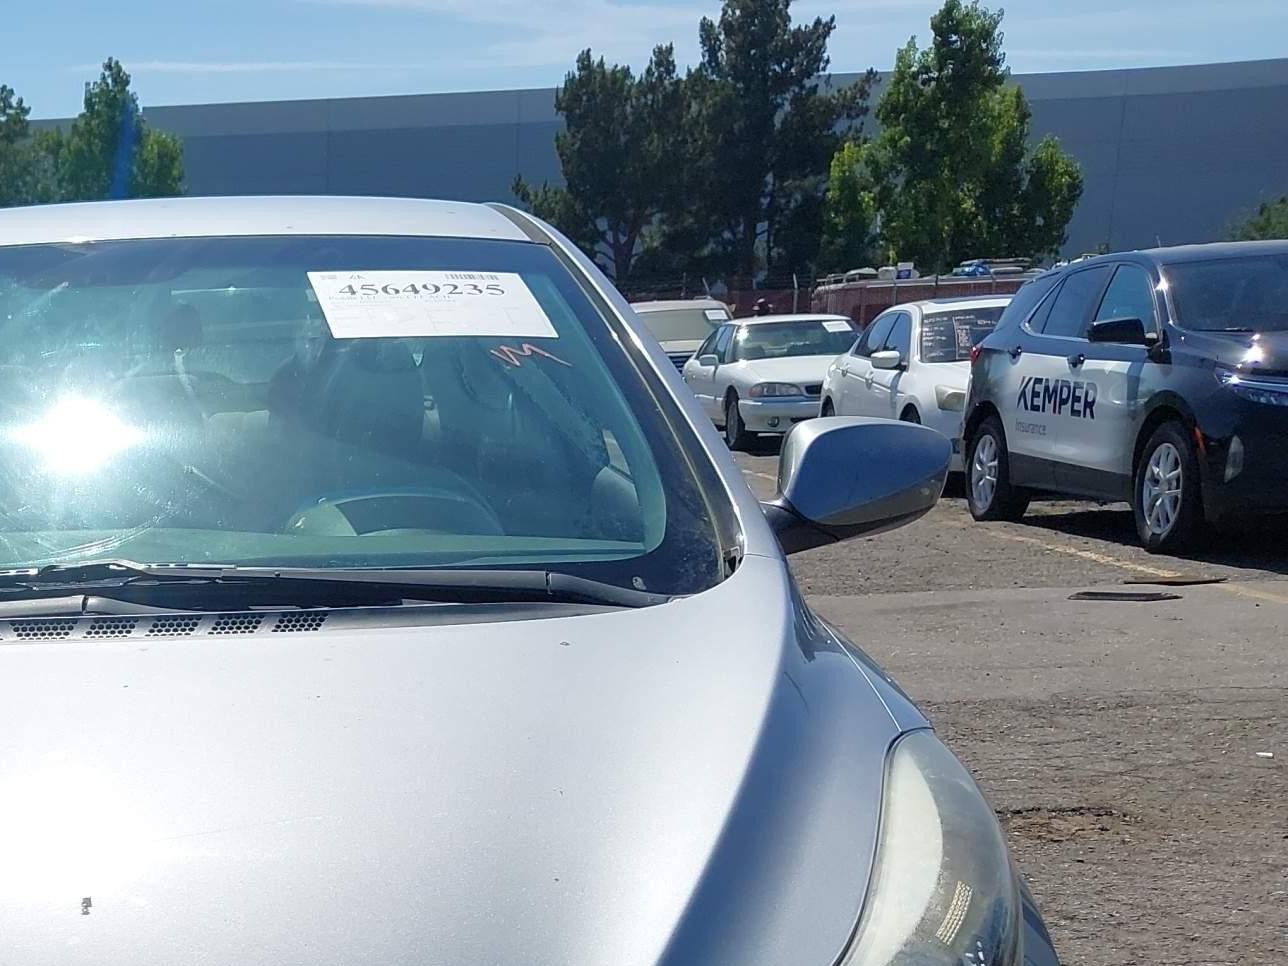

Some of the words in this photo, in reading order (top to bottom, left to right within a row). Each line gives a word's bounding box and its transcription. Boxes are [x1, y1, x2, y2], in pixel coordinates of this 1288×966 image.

[339, 283, 505, 296] 45649235
[1017, 376, 1098, 419] KEMPER
[1016, 420, 1047, 436] Insurance
